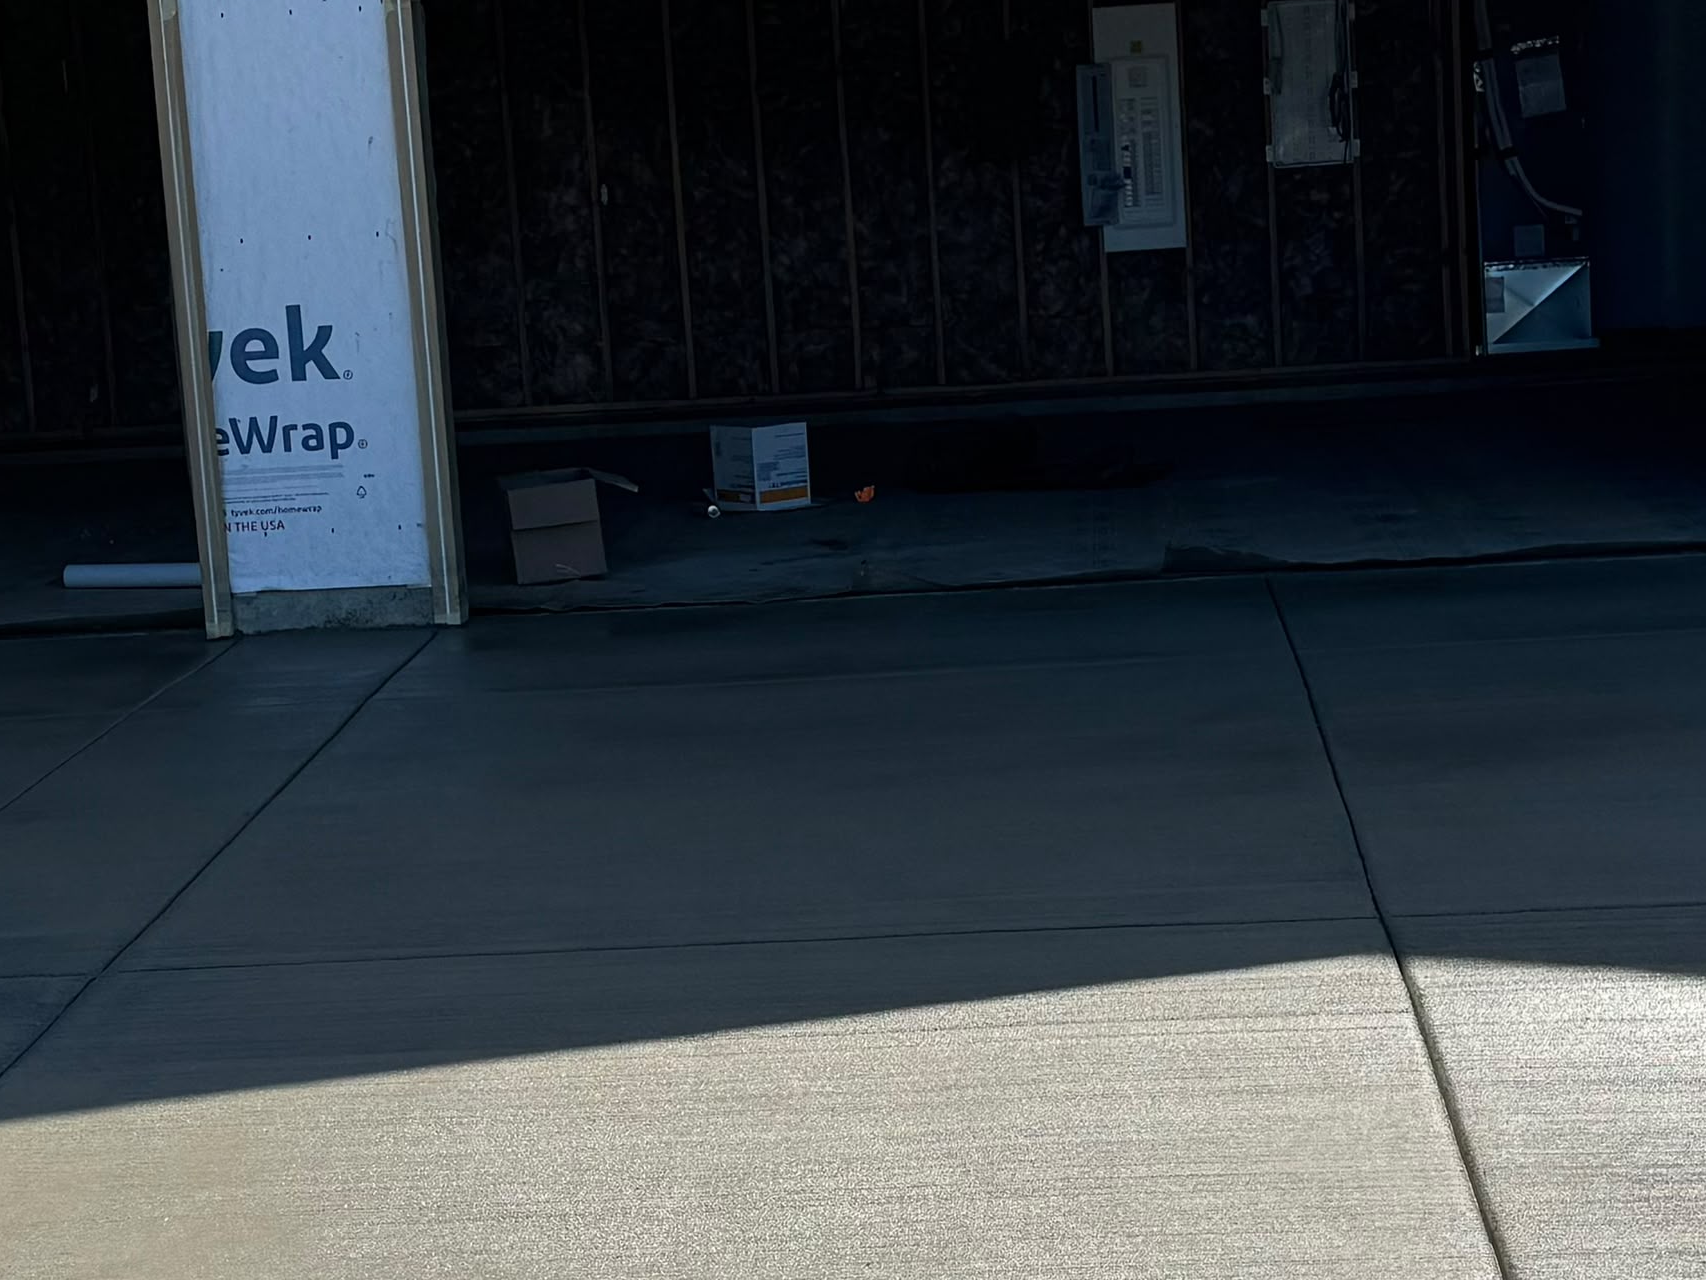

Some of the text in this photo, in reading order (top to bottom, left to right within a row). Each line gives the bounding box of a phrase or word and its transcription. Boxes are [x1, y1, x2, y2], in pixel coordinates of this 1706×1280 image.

[231, 505, 323, 518] tyvek.com/homewrap
[235, 520, 258, 532] THE
[261, 519, 286, 531] USA
